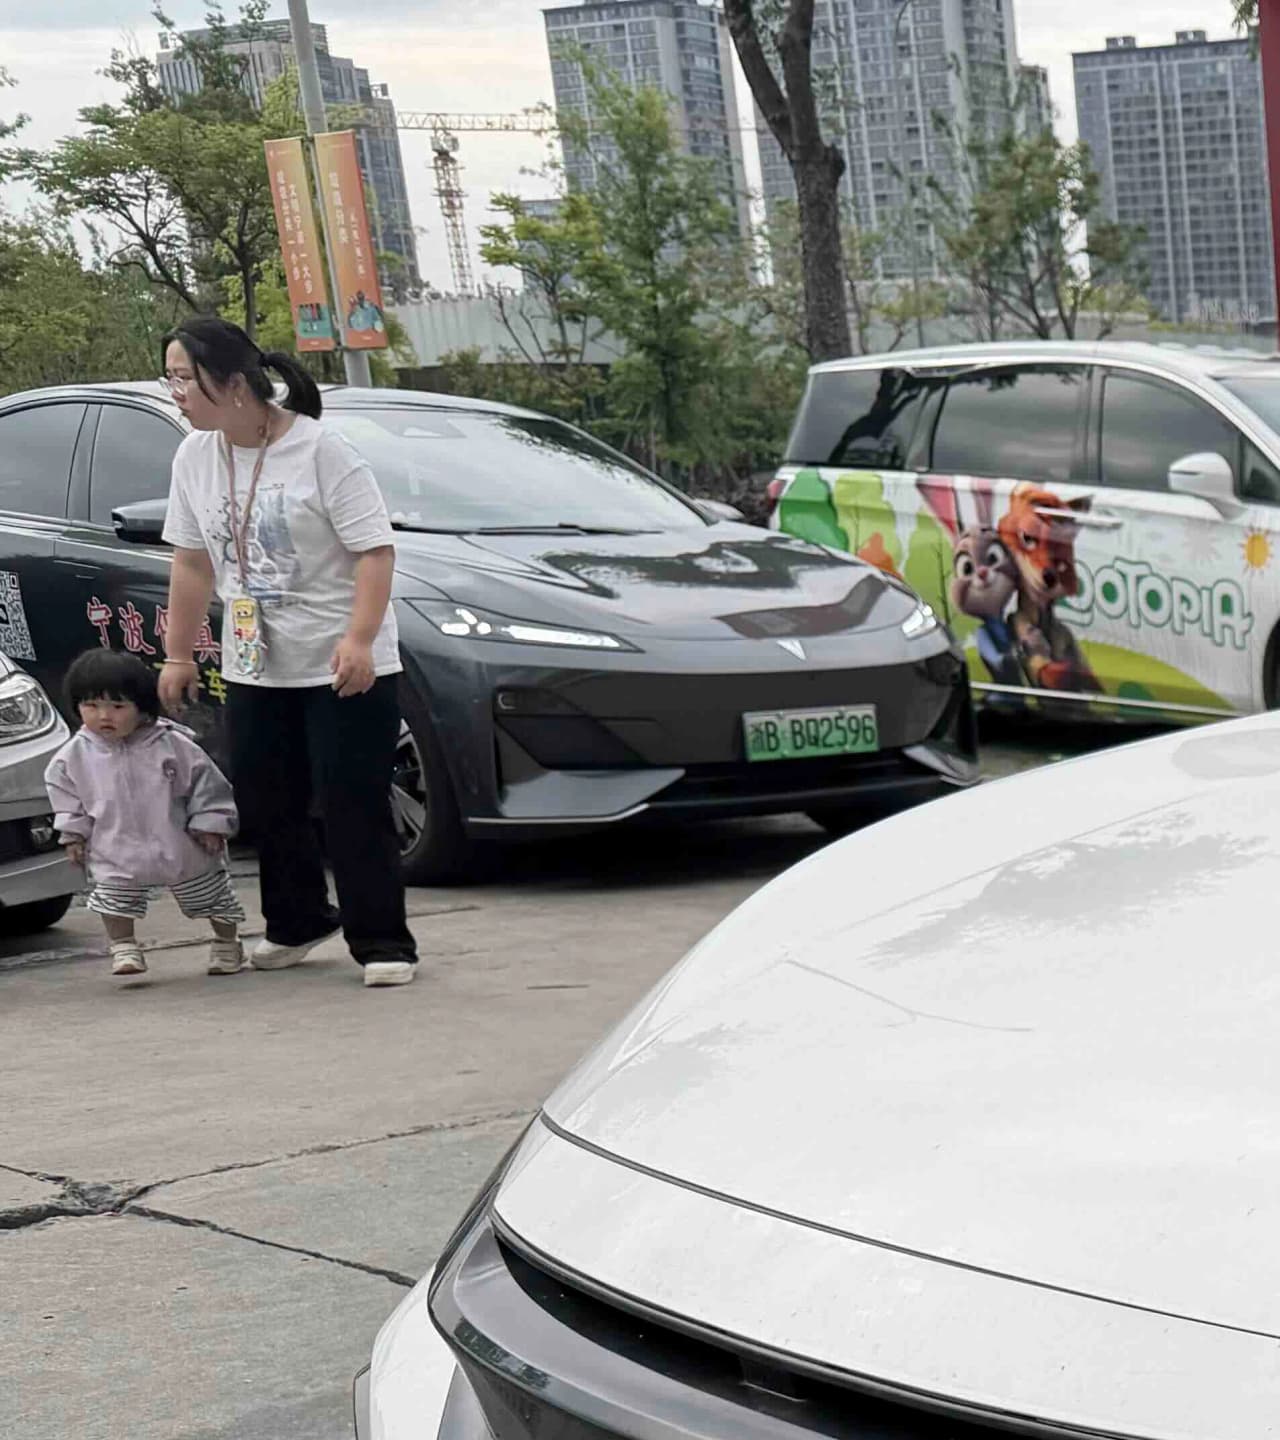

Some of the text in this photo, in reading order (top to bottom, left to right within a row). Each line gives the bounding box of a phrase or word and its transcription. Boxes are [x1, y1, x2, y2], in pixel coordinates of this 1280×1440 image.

[87, 596, 222, 665] 宁波真
[791, 714, 877, 750] BQ2596
